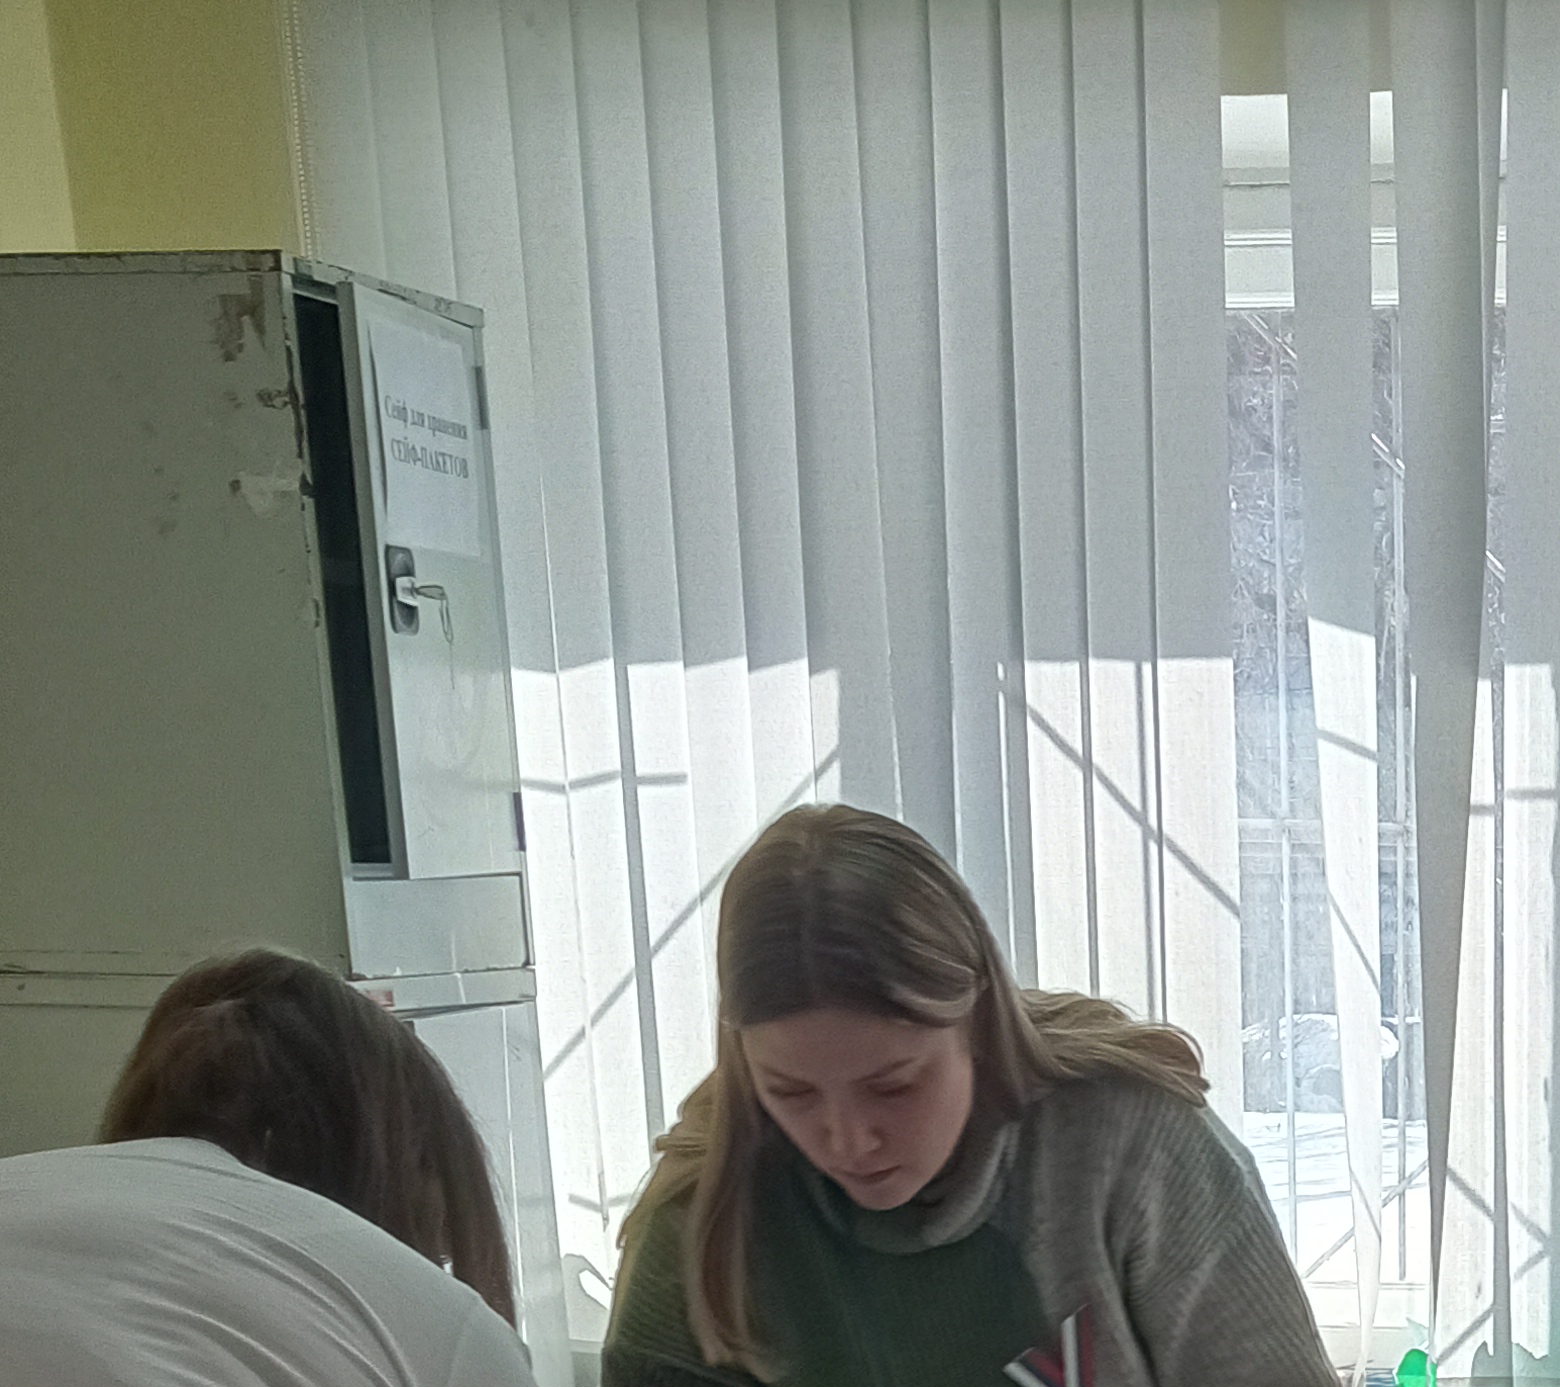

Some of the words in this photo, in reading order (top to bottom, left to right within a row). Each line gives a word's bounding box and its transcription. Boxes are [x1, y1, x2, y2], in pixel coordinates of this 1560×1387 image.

[385, 395, 408, 429] Сейф
[410, 409, 425, 428] для
[427, 414, 467, 440] хранения
[391, 436, 469, 479] СЕЙФ-ПАКЕТОВ
